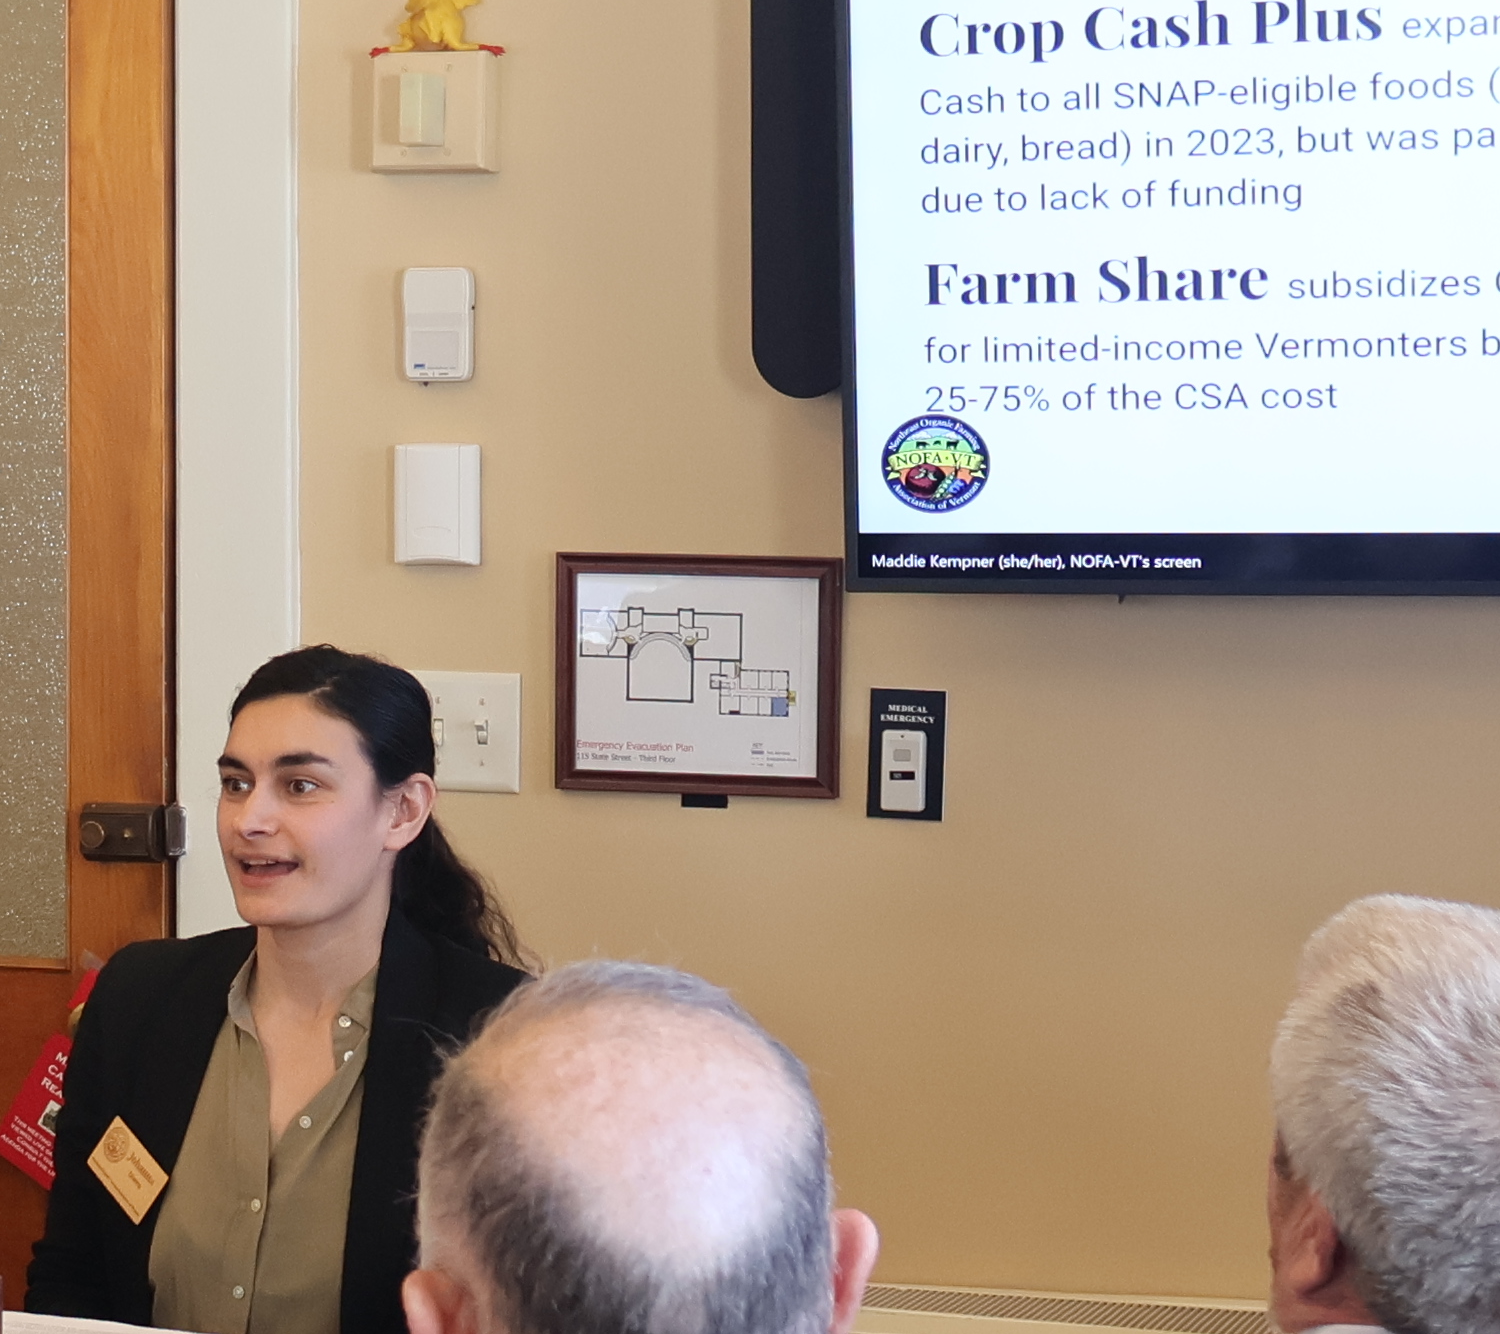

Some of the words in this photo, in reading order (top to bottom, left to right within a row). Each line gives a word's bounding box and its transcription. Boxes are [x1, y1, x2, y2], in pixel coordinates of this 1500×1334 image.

[920, 14, 1064, 63] Crop
[1085, 0, 1229, 50] Cash
[920, 86, 1004, 115] Cash
[1017, 89, 1049, 112] to
[1064, 82, 1099, 110] all
[1114, 74, 1356, 111] SNAP-eligible
[1370, 70, 1474, 100] foods
[921, 137, 1008, 170] dairy,
[1022, 130, 1130, 165] bread)
[1147, 132, 1172, 157] in
[1188, 128, 1283, 158] 2023,
[1298, 126, 1353, 153] but
[1367, 129, 1438, 150] was
[922, 187, 982, 213] due
[994, 188, 1027, 212] to
[1041, 182, 1109, 210] lack
[1122, 180, 1156, 208] of
[1169, 178, 1301, 211] funding
[926, 264, 1077, 305] Farm
[1099, 256, 1268, 302] Share
[1289, 269, 1480, 299] subsidizes
[924, 337, 971, 363] for
[984, 334, 1242, 362] limited-income
[1255, 333, 1467, 359] Vermonters
[926, 385, 1049, 412] 25-75%
[1063, 383, 1096, 411] of
[1107, 383, 1161, 410] the
[1175, 383, 1248, 409] CSA
[1262, 384, 1337, 409] cost
[920, 419, 954, 429] Organic
[937, 500, 948, 510] of
[949, 481, 980, 506] Vermont
[872, 554, 926, 568] Maddie
[930, 554, 994, 571] Kempner
[998, 554, 1065, 571] (she/her),
[1070, 554, 1149, 568] NOFA-VT's
[1154, 557, 1201, 569] screen
[880, 713, 935, 724] EMERGENCY
[888, 704, 928, 714] MEDICAL
[576, 740, 624, 751] Emergency
[626, 741, 673, 752] Evacuation
[676, 743, 694, 752] Plan
